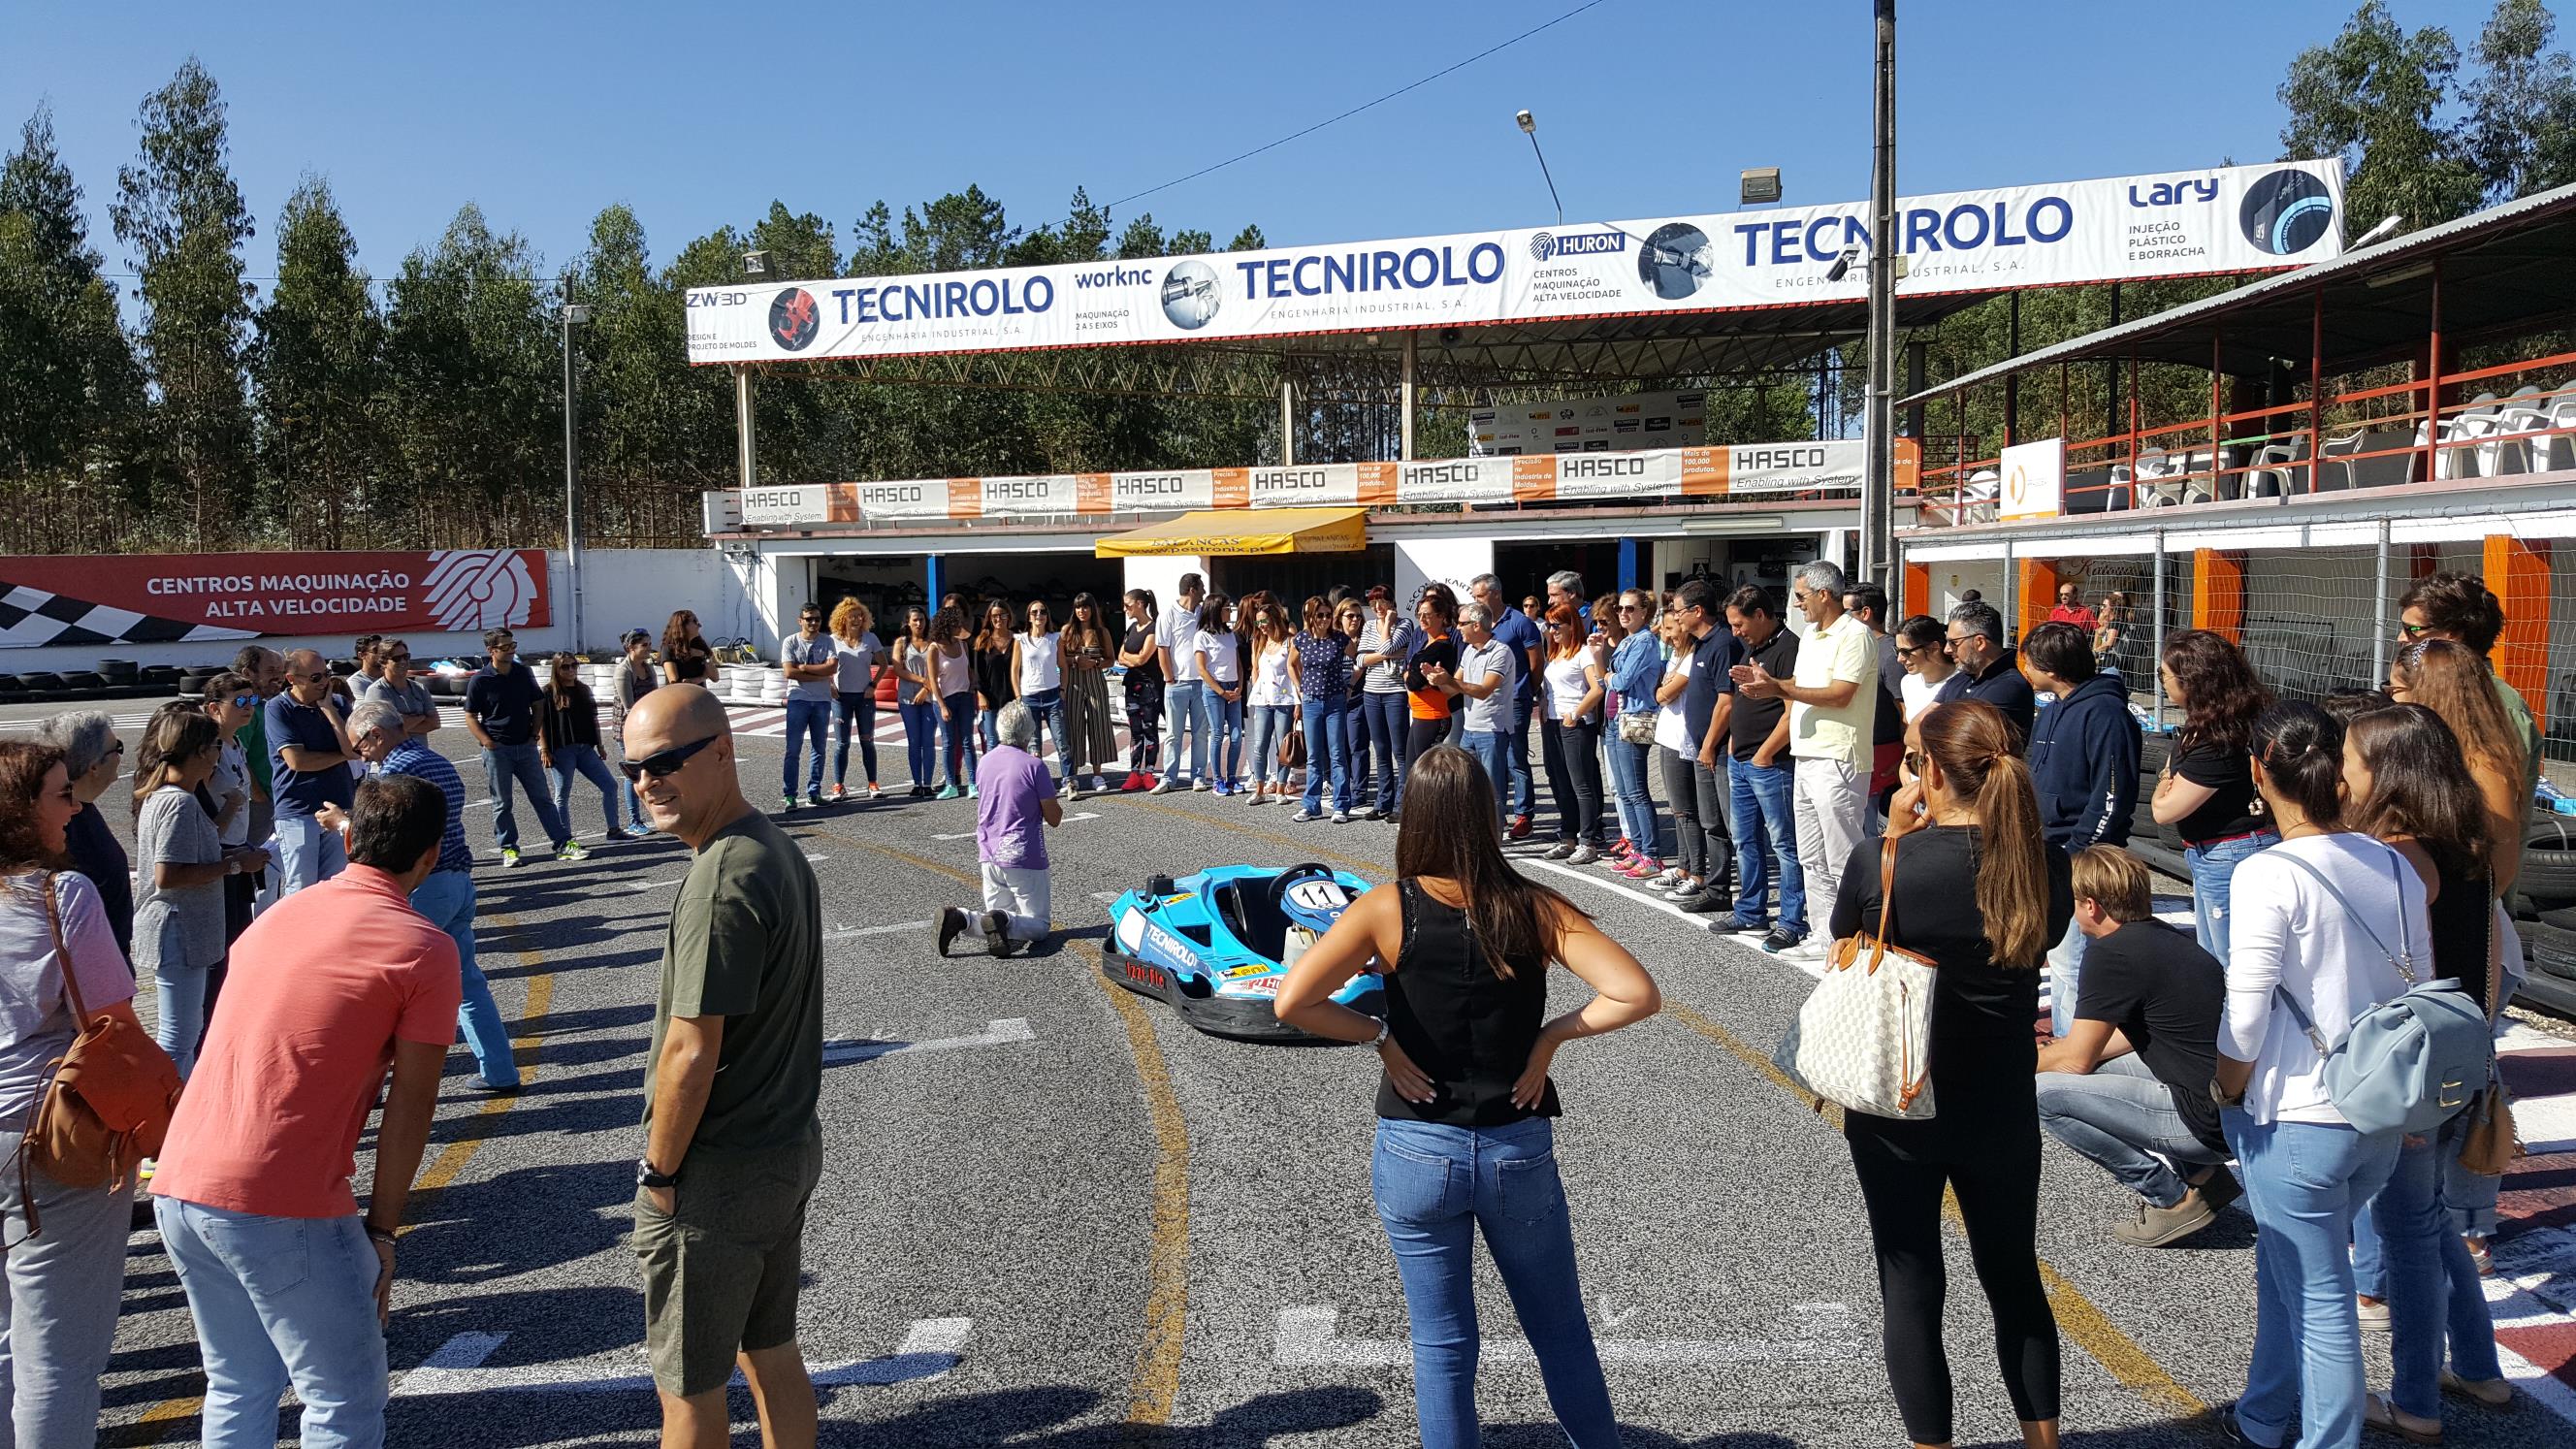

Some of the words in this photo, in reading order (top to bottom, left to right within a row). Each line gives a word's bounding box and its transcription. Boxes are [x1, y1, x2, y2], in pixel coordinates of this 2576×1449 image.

[1734, 196, 2074, 267] TECNIROLO
[2129, 221, 2180, 235] INJEÇÃO
[1562, 236, 1620, 253] HURON
[2129, 234, 2186, 247] PLÁSTICO
[2139, 246, 2206, 260] BORRACHA
[1237, 242, 1504, 301] TECNIROLO
[1533, 268, 1578, 279] CENTROS
[1533, 276, 1600, 291] MAQUINAÇÃO
[1776, 273, 1866, 288] ENGENARI
[831, 274, 1054, 325] TECNIROLO
[1532, 292, 1558, 303] ALTA
[1560, 289, 1622, 301] VELOCIDADE
[1075, 308, 1130, 320] MAQUINAÇÃO
[1271, 306, 1348, 319] ENGENHARIA
[1355, 302, 1435, 314] INDUSTRIAL,
[1095, 321, 1118, 330] EIXOS
[861, 332, 928, 342] ENGENHARIA
[932, 328, 999, 338] INDUSTRIAL,
[688, 341, 718, 350] PROJETO
[731, 340, 757, 349] MOLDES
[1737, 448, 1824, 470] HASCO
[1404, 466, 1478, 484] HASCO
[1564, 458, 1644, 477] HASCO
[1117, 477, 1182, 495] HASCO
[1256, 471, 1326, 489] HASCO
[1736, 477, 1784, 488] Enabling
[1787, 476, 1810, 486] with
[1813, 475, 1858, 485] System.
[863, 487, 921, 503] HASCO
[986, 482, 1047, 499] HASCO
[1447, 490, 1465, 499] with
[1563, 485, 1607, 494] Enabling
[1610, 484, 1630, 493] with
[1633, 483, 1675, 493] System.
[746, 492, 800, 508] HASCO
[793, 512, 823, 521] System.
[146, 575, 254, 596] CENTROS
[259, 569, 409, 594] MAQUINAÇÃO
[1405, 579, 1437, 612] ESCOA
[205, 599, 265, 618] ALTA
[269, 596, 407, 616] VELOCIDADE
[1302, 885, 1332, 906] 11
[1146, 923, 1195, 967] TECNIROLO
